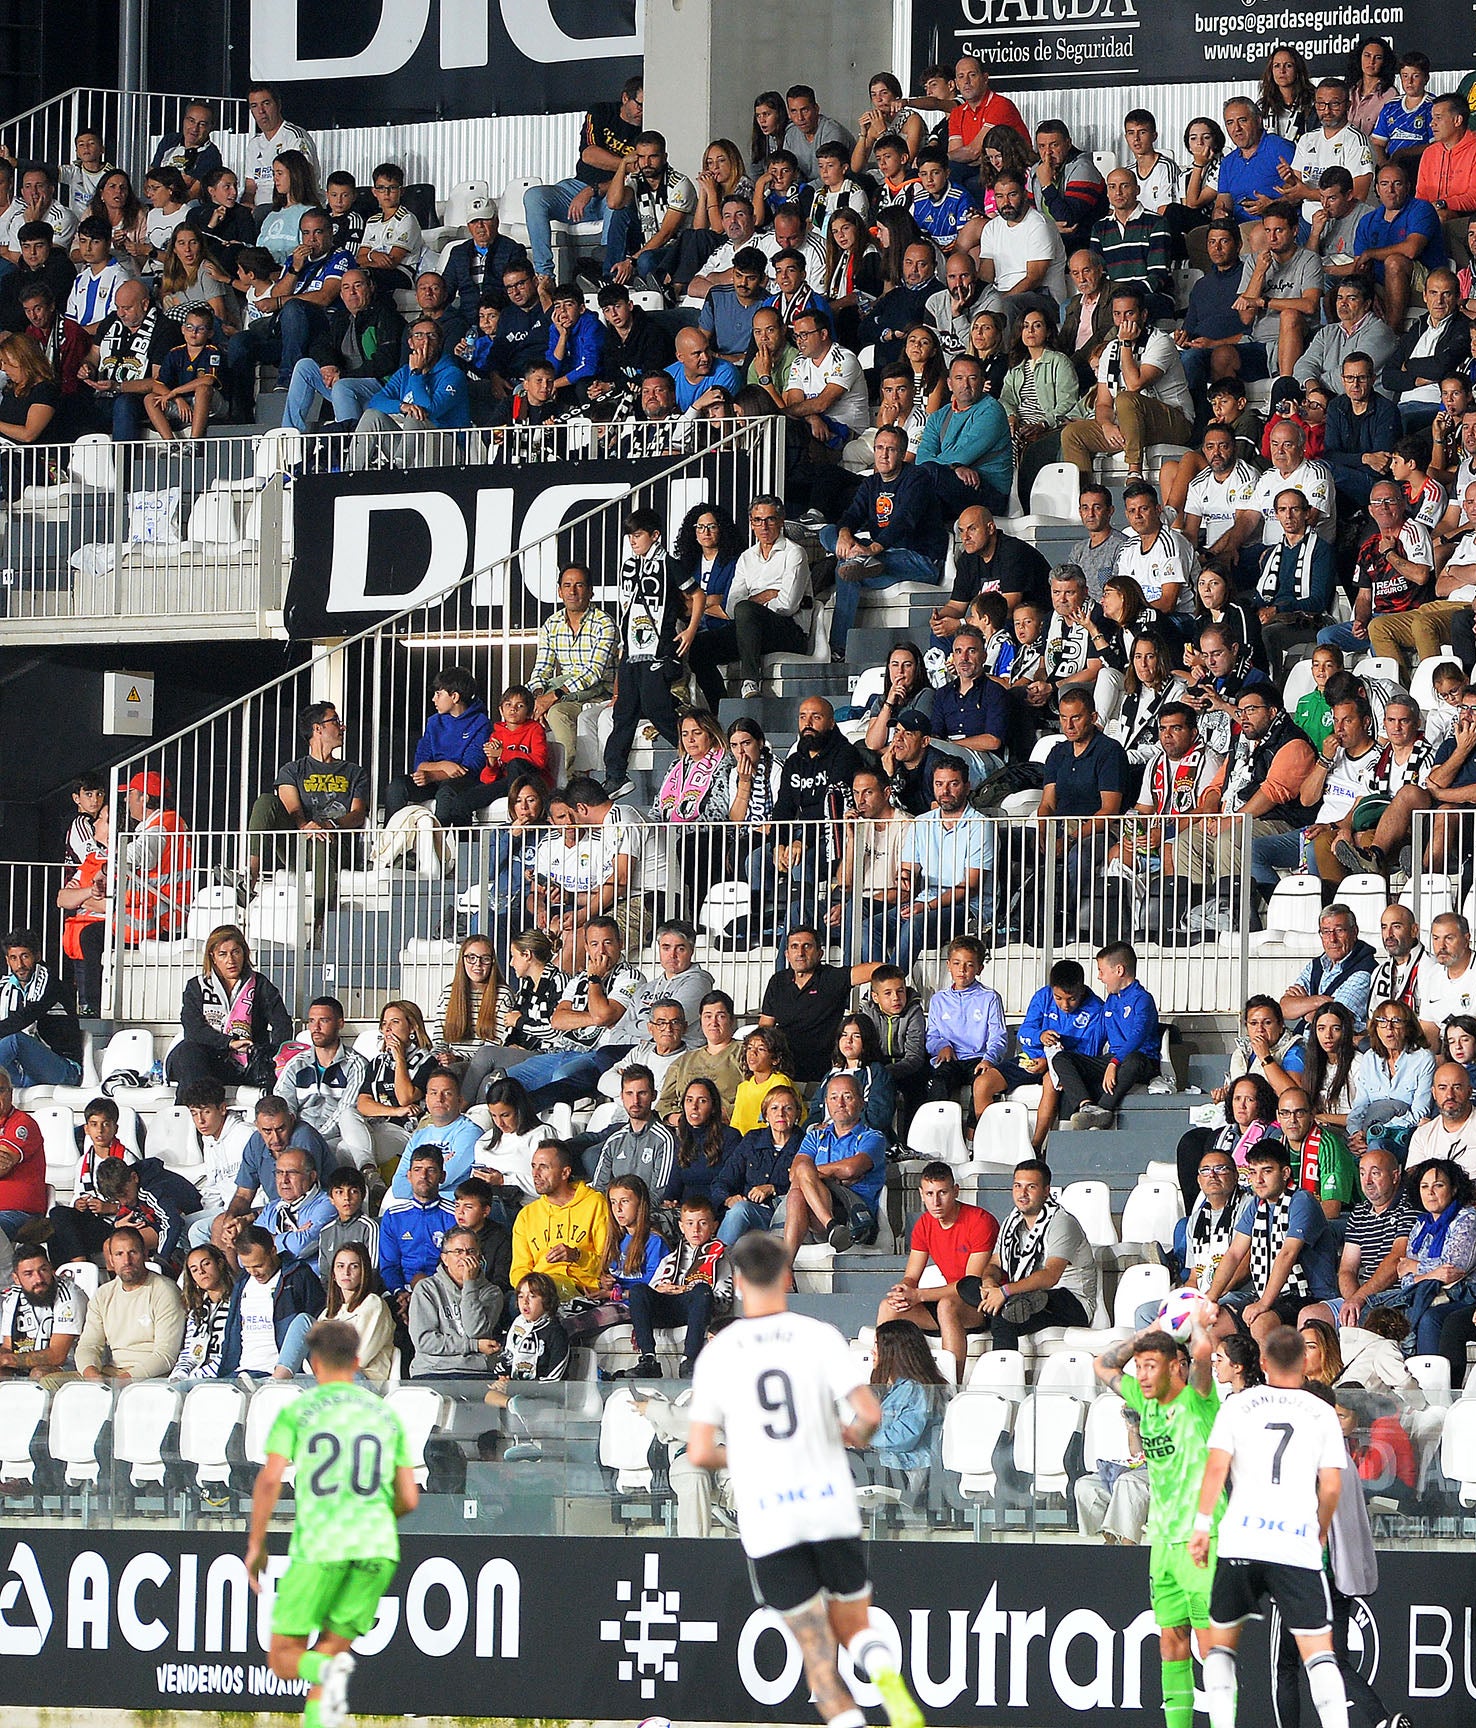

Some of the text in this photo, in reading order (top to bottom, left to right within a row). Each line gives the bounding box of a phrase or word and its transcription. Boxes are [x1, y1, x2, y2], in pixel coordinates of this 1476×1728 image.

[1195, 5, 1404, 36] burgos@gardaseguridad.com
[962, 35, 1134, 65] Servicios de Seguridad
[1376, 577, 1406, 588] REALE
[303, 780, 349, 793] WARS
[307, 774, 348, 785] STAR
[1333, 785, 1356, 798] REAL
[530, 1224, 587, 1247] TOKYO
[246, 1315, 272, 1324] REAL
[757, 1369, 797, 1439] 9
[309, 1432, 382, 1497] 20
[1264, 1422, 1295, 1485] 7
[157, 1663, 244, 1696] VENDEMOS
